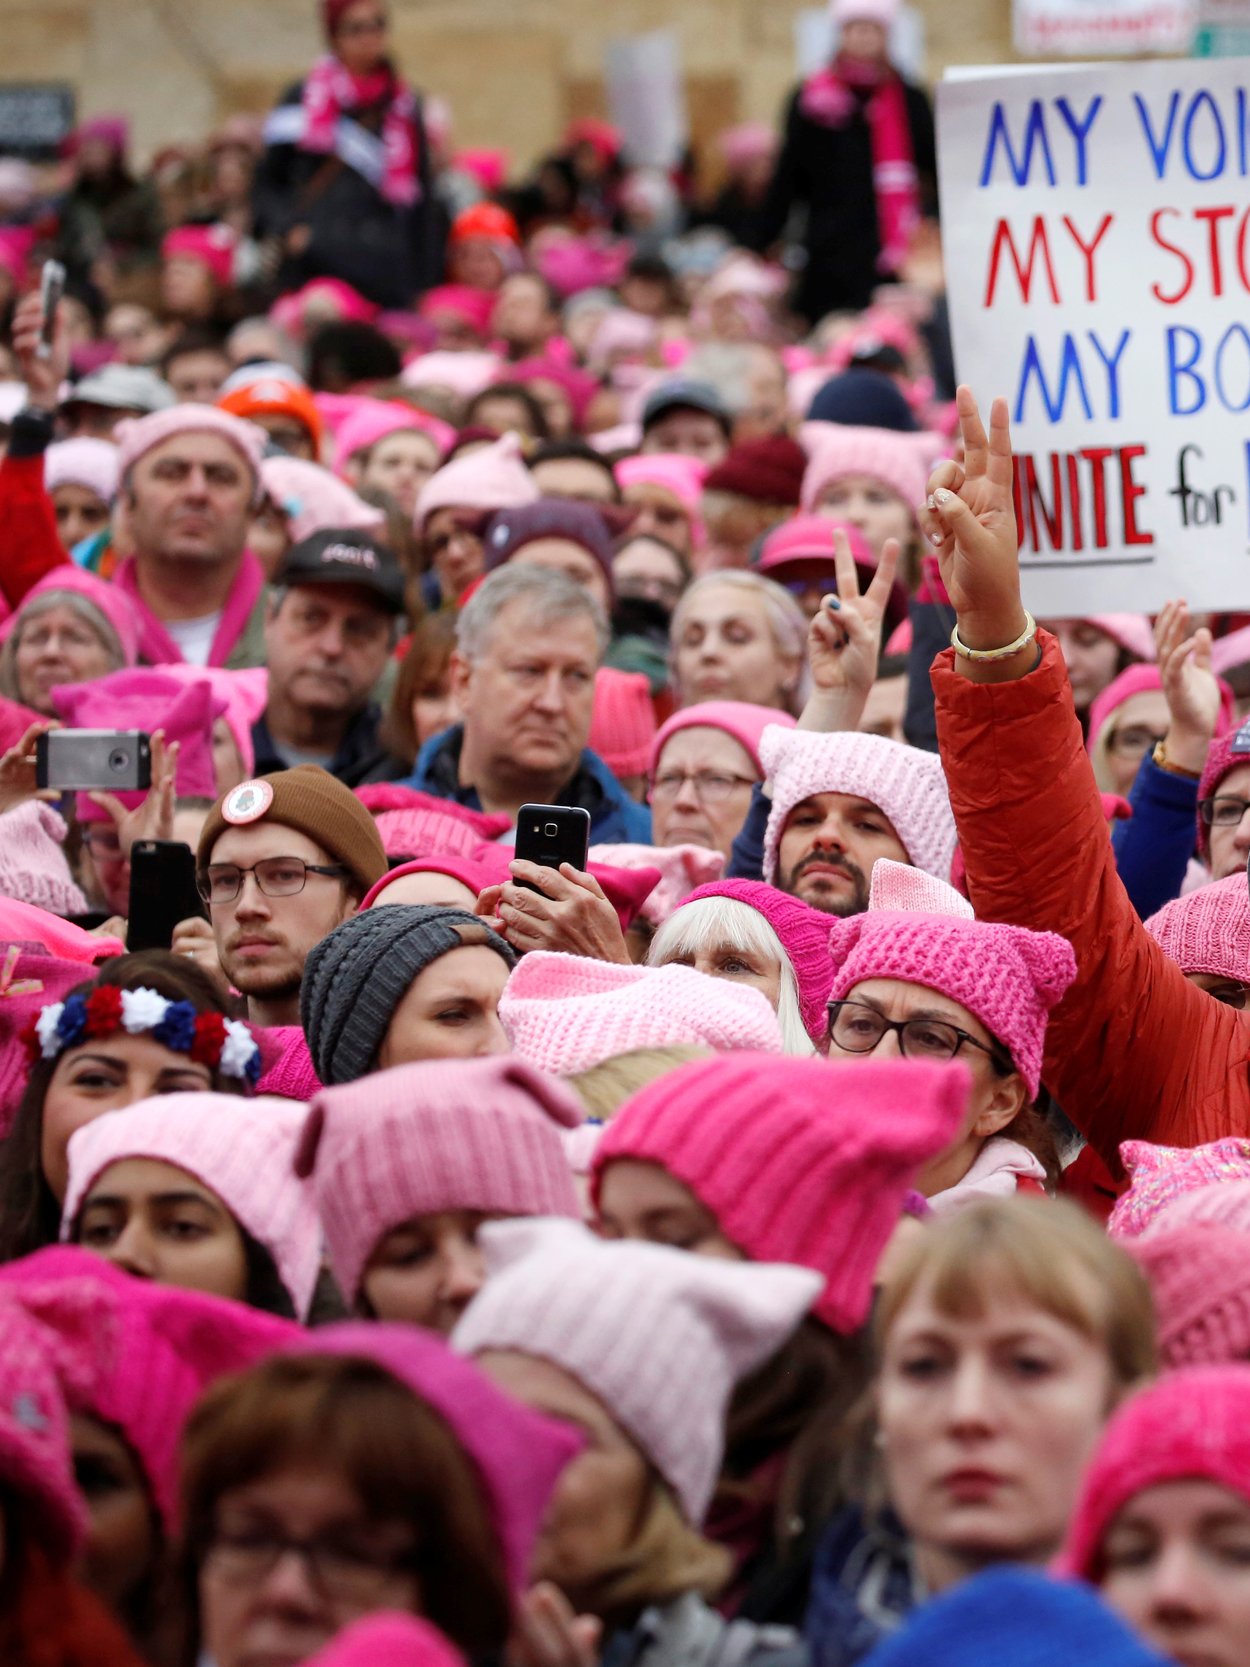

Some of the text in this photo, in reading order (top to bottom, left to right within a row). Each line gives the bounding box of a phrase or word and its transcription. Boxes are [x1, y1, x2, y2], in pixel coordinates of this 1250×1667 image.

[979, 94, 1103, 187] MY
[983, 213, 1114, 308] MY
[1014, 328, 1131, 424] MY
[1170, 443, 1235, 527] for
